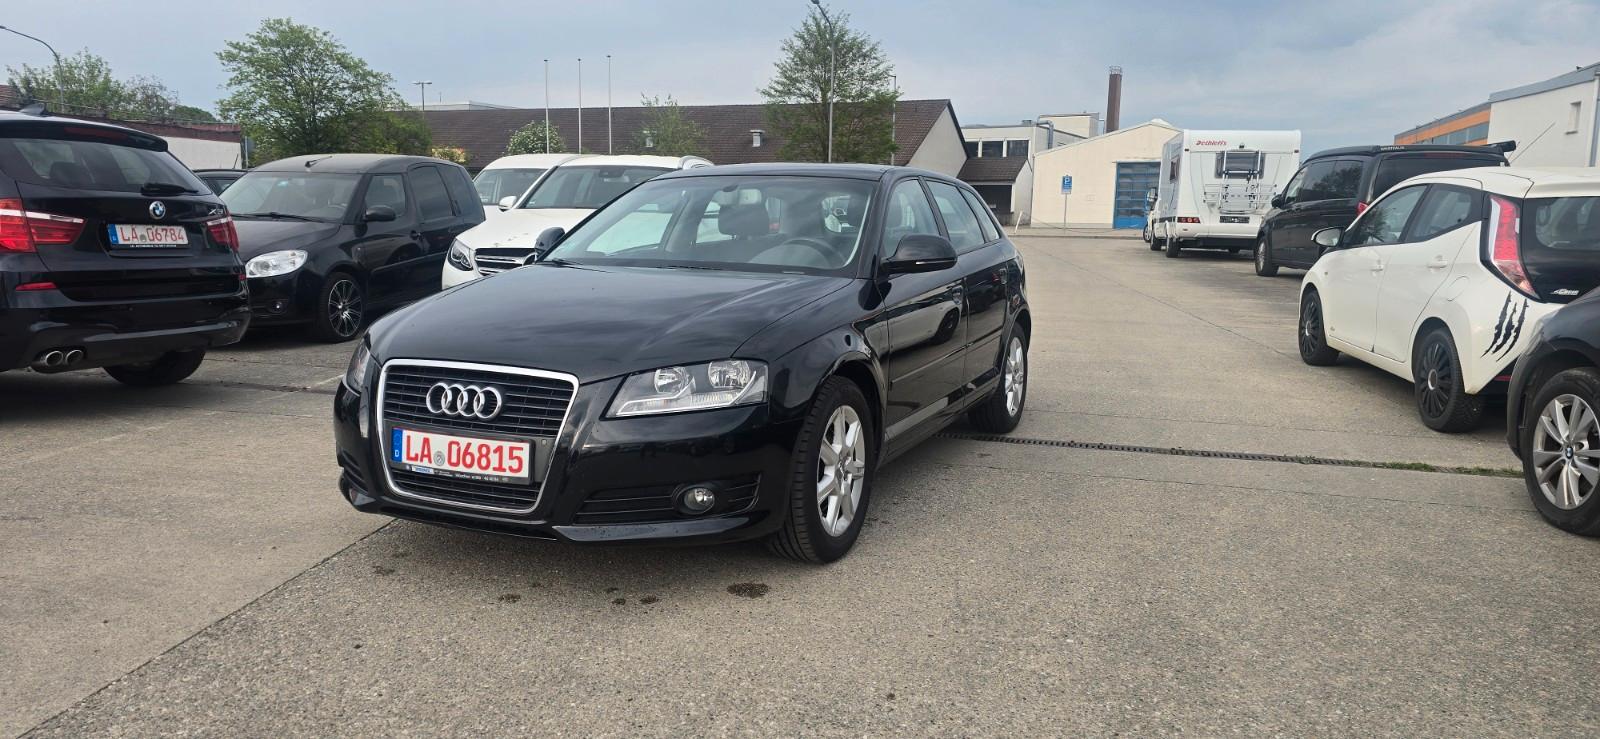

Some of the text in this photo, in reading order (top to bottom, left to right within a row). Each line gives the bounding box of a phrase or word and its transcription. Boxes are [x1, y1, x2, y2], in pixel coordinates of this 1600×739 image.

[120, 226, 184, 242] LA 06784
[406, 435, 432, 464] LA
[447, 441, 524, 473] 06815
